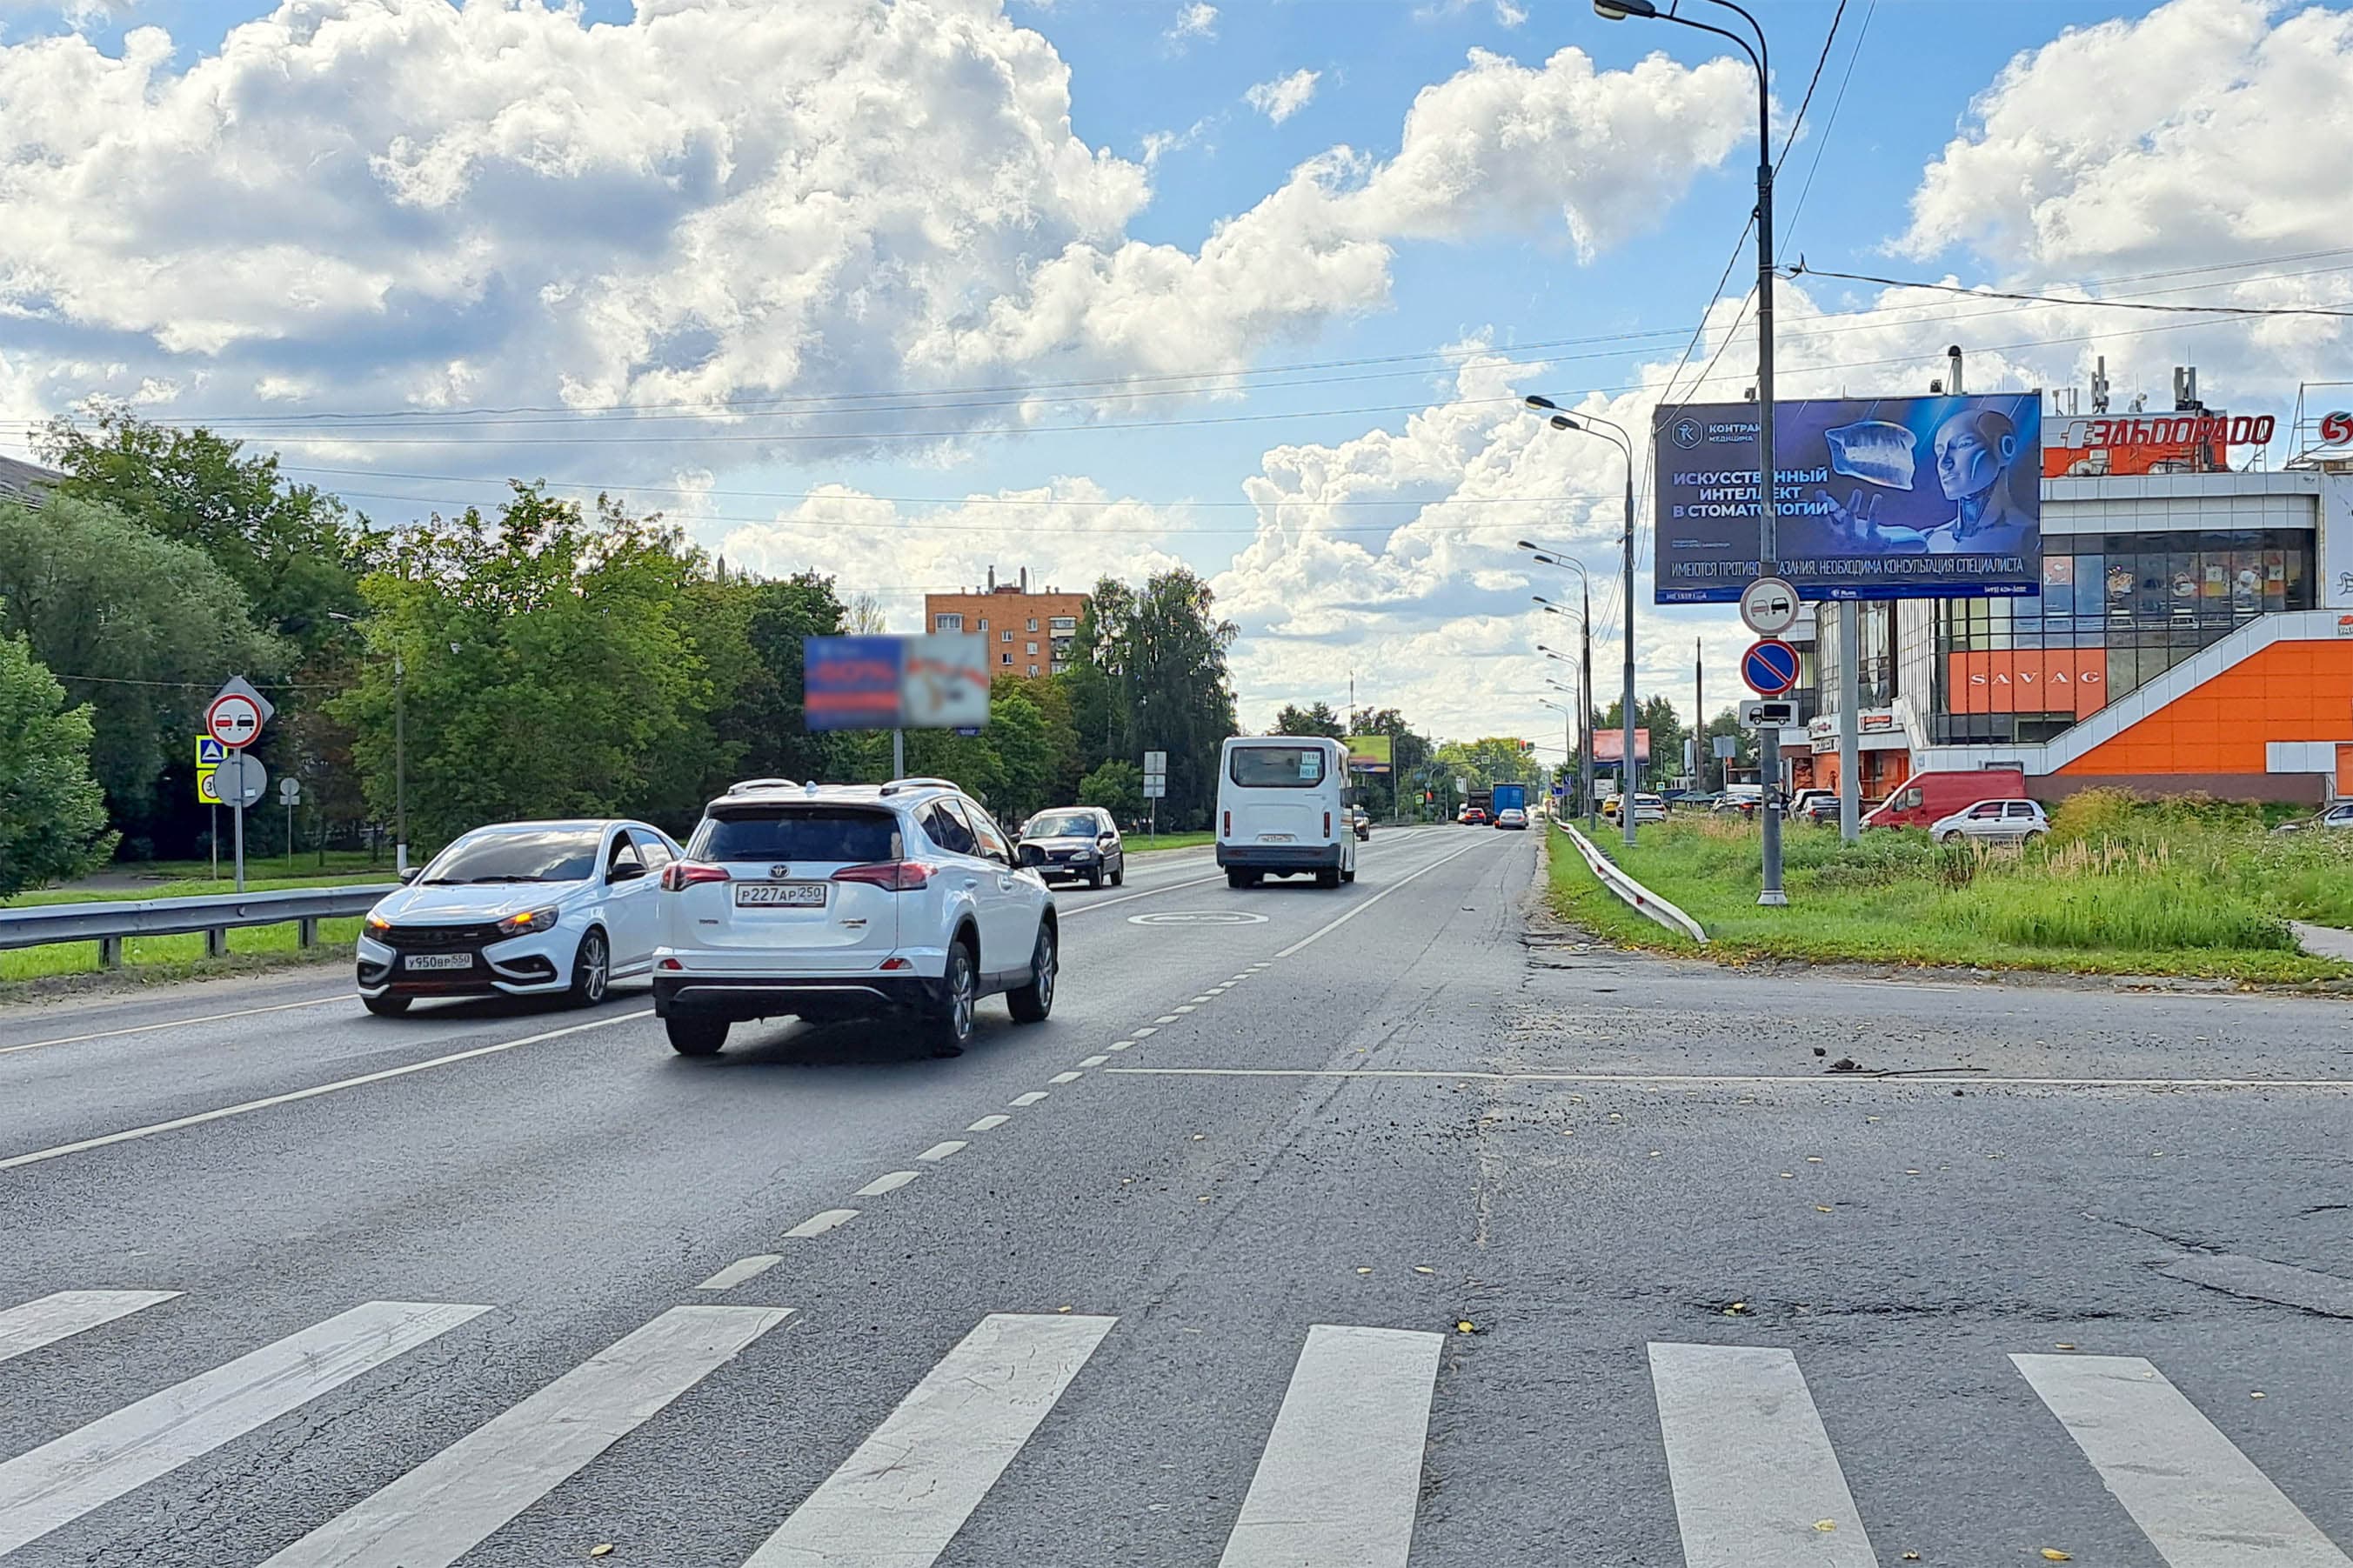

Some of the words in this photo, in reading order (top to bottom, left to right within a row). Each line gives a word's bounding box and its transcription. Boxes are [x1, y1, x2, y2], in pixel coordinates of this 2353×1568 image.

[1674, 467, 1828, 484] ИСКУССТВННЫЙ
[1700, 487, 1802, 501] ИНТЕЛЕКТ
[1673, 504, 1685, 517] В
[1671, 563, 1717, 577] ИМЕЮТСЯ
[1720, 561, 1817, 576] ПРОТИВОАЗАНИЯ.
[1819, 559, 1882, 576] НЕОБХОДИМА
[1884, 557, 1954, 577] КОНСУЛЬТАЦИЯ
[1956, 557, 2024, 575] СПЕЦИАЛИСТА
[1970, 671, 2101, 686] SAVAG
[207, 782, 212, 791] 3
[741, 888, 796, 901] Р227АР
[799, 886, 821, 898] 250
[409, 957, 451, 968] У950ВР
